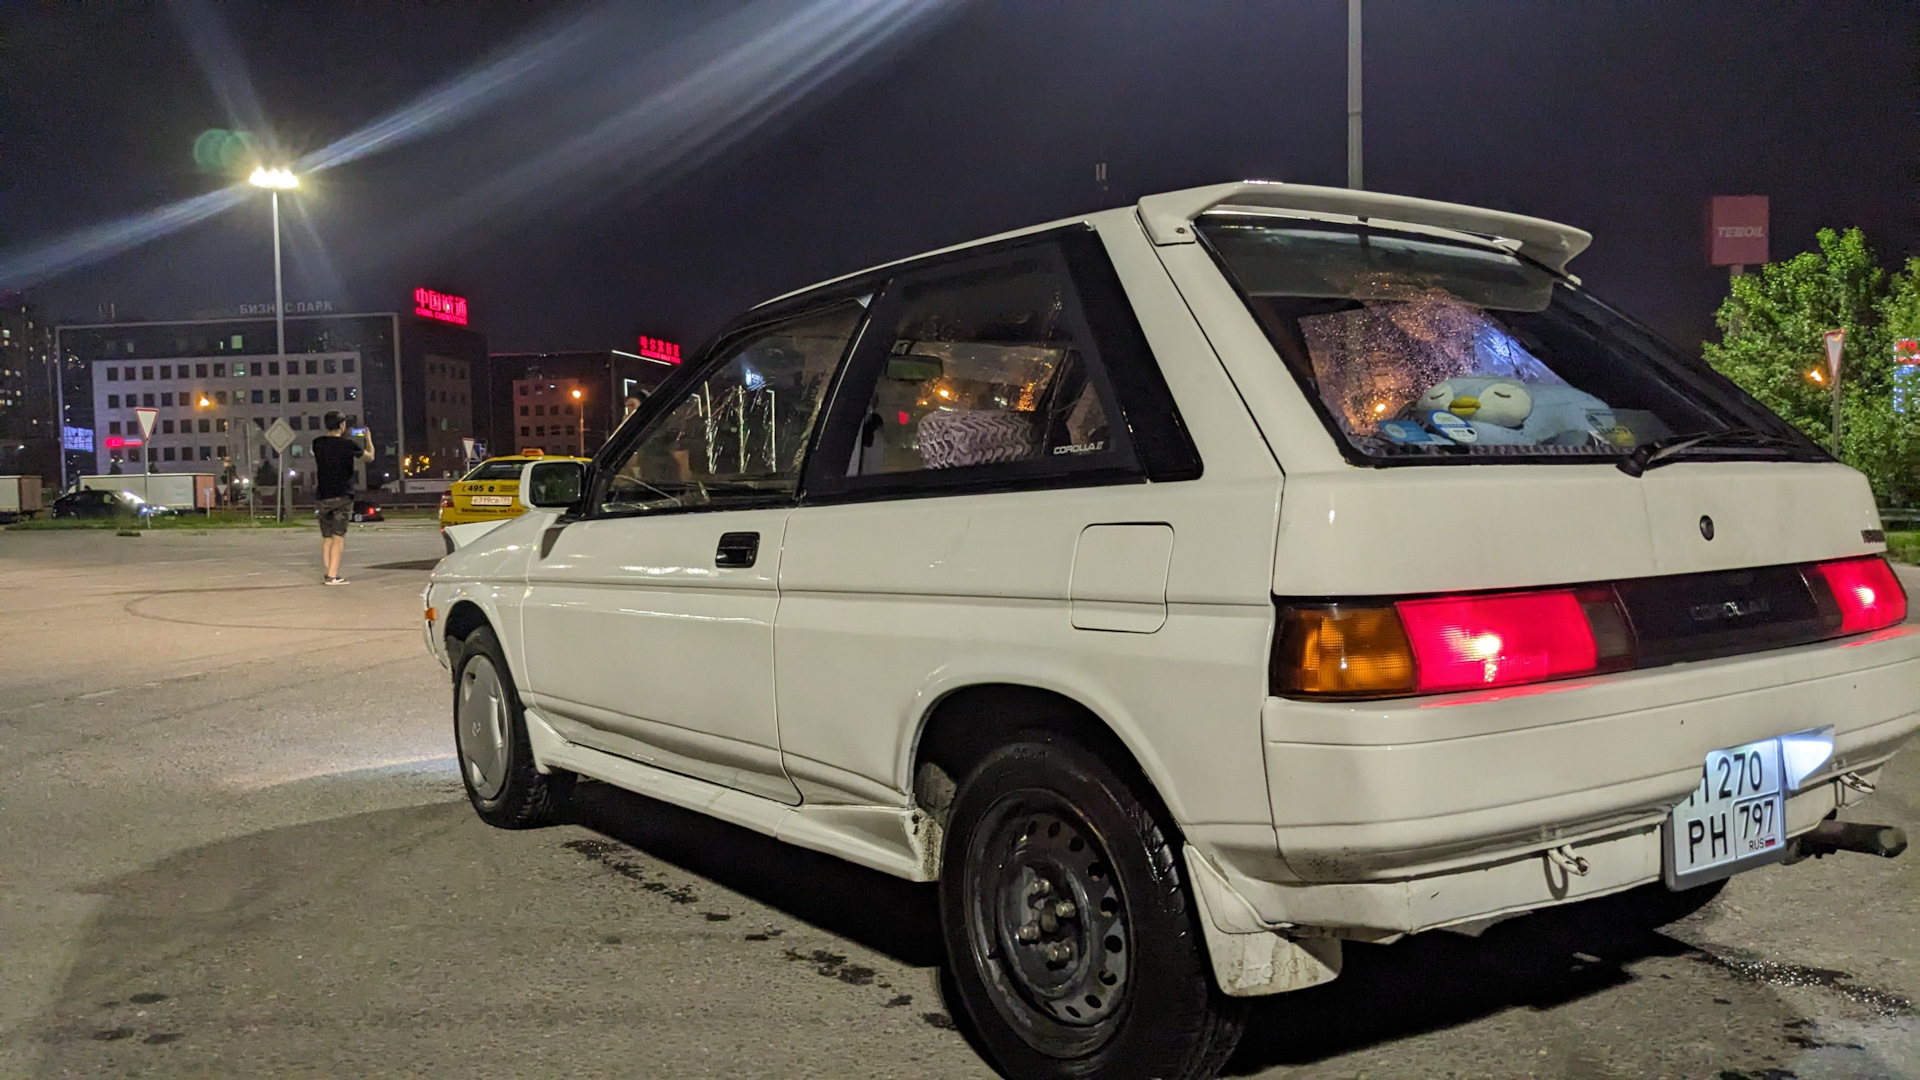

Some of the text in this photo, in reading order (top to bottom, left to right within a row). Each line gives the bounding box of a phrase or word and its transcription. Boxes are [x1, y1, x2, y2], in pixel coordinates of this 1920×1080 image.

[1716, 226, 1765, 238] TEBOIL
[239, 301, 333, 315] БИЗНС ПАРК
[1053, 443, 1096, 455] COROLLA
[1716, 750, 1763, 800] 270
[1738, 799, 1774, 839] 797
[1748, 837, 1765, 852] RUS
